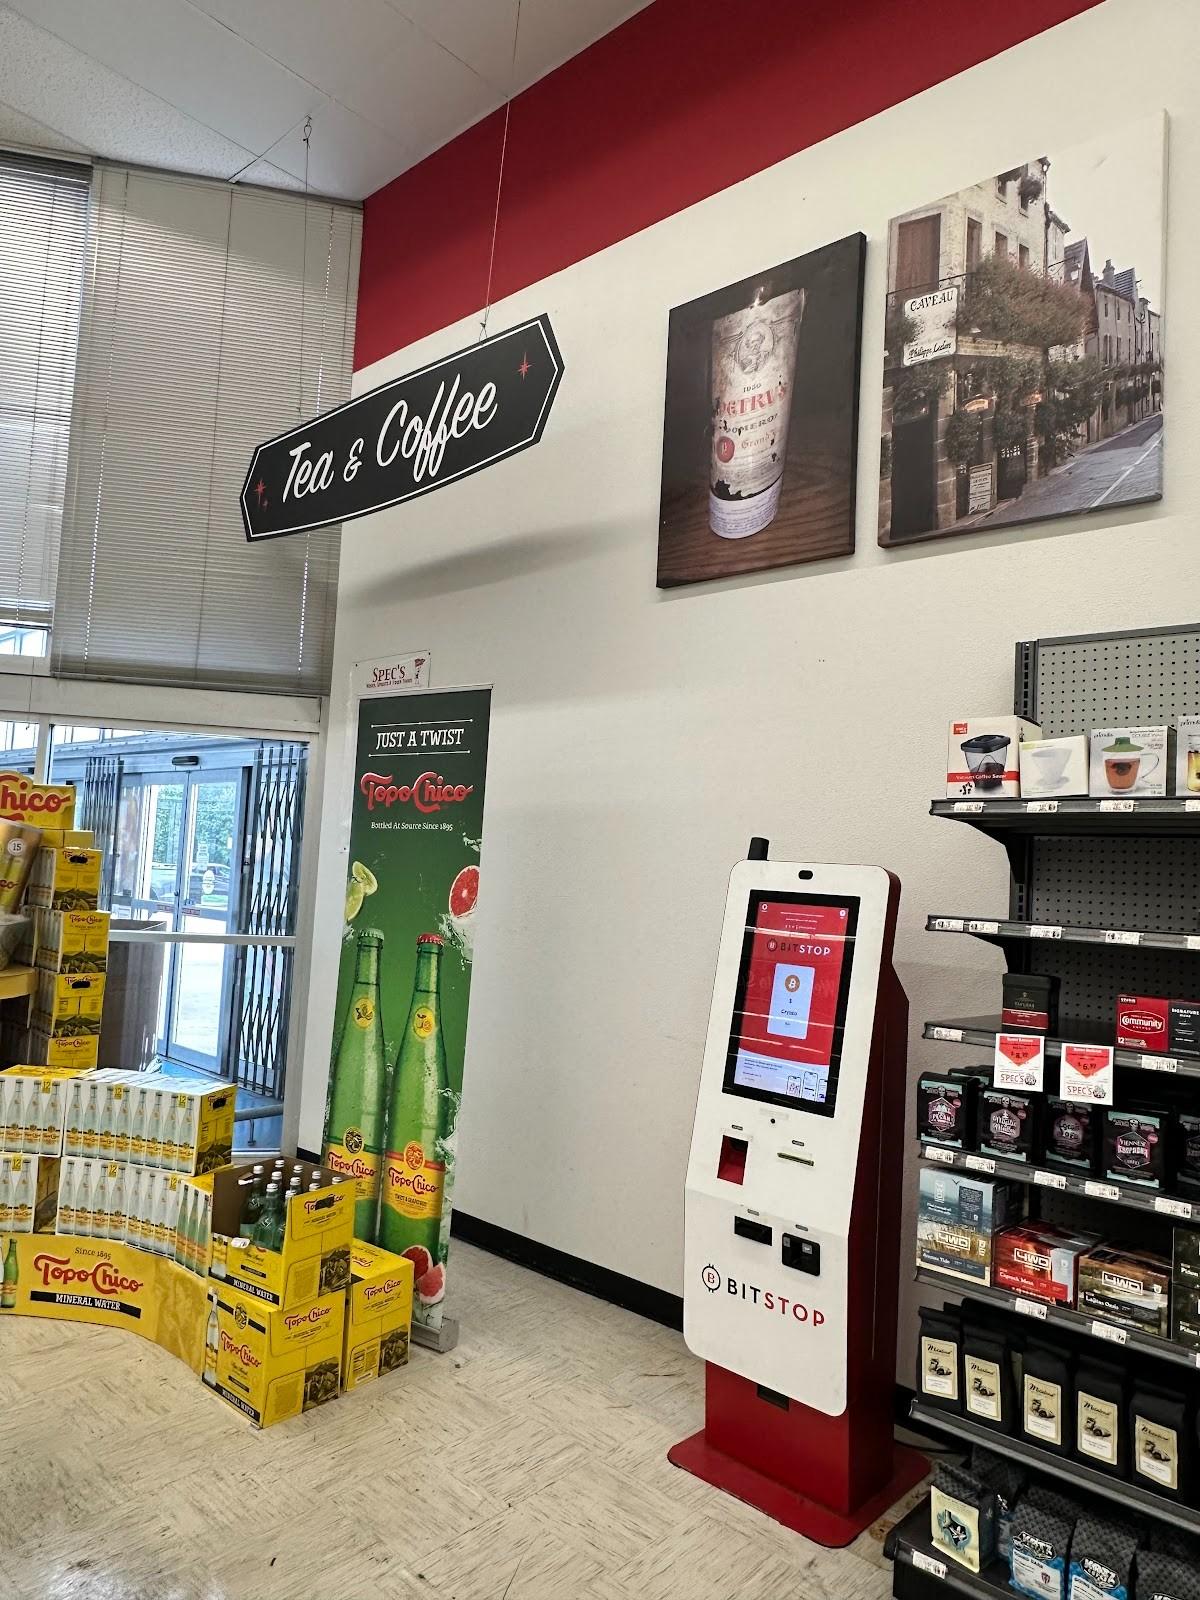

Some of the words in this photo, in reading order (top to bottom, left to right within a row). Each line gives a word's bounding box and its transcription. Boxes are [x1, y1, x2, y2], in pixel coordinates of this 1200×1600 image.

[910, 291, 954, 312] CAVEAU
[282, 442, 334, 503] Tea
[343, 438, 364, 483] &
[376, 373, 498, 483] Coffee
[372, 664, 406, 683] SPEC'S
[376, 731, 405, 750] JUST
[406, 730, 417, 747] A
[420, 728, 464, 746] TWIST
[361, 772, 411, 811] Topo
[411, 771, 474, 813] Chico
[401, 822, 422, 830] Source
[422, 822, 439, 830] Since
[13, 842, 22, 851] 15
[780, 942, 831, 956] BITSTOP
[1122, 1015, 1163, 1029] Community
[43, 1081, 50, 1089] 12
[1000, 1073, 1025, 1083] SPEC'S
[1066, 1085, 1093, 1096] SPEC'S
[13, 1158, 21, 1167] 12
[109, 1165, 117, 1174] 12
[328, 1151, 352, 1171] Topo
[352, 1158, 377, 1179] Chico
[170, 1177, 177, 1185] 12
[388, 1166, 412, 1187] Topo
[412, 1174, 440, 1194] Chico
[74, 1247, 96, 1257] Since
[97, 1250, 112, 1261] 1895
[34, 1254, 92, 1286] Topo
[92, 1262, 144, 1295] Chico
[364, 1285, 382, 1300] Topo
[383, 1279, 403, 1294] Chico
[55, 1293, 93, 1307] MINERAL
[94, 1298, 121, 1311] WATER
[727, 1277, 825, 1327] BITSTOP
[284, 1313, 308, 1331] Topo
[308, 1306, 332, 1322] Chico
[221, 1330, 240, 1355] Topo
[240, 1344, 262, 1367] Chico
